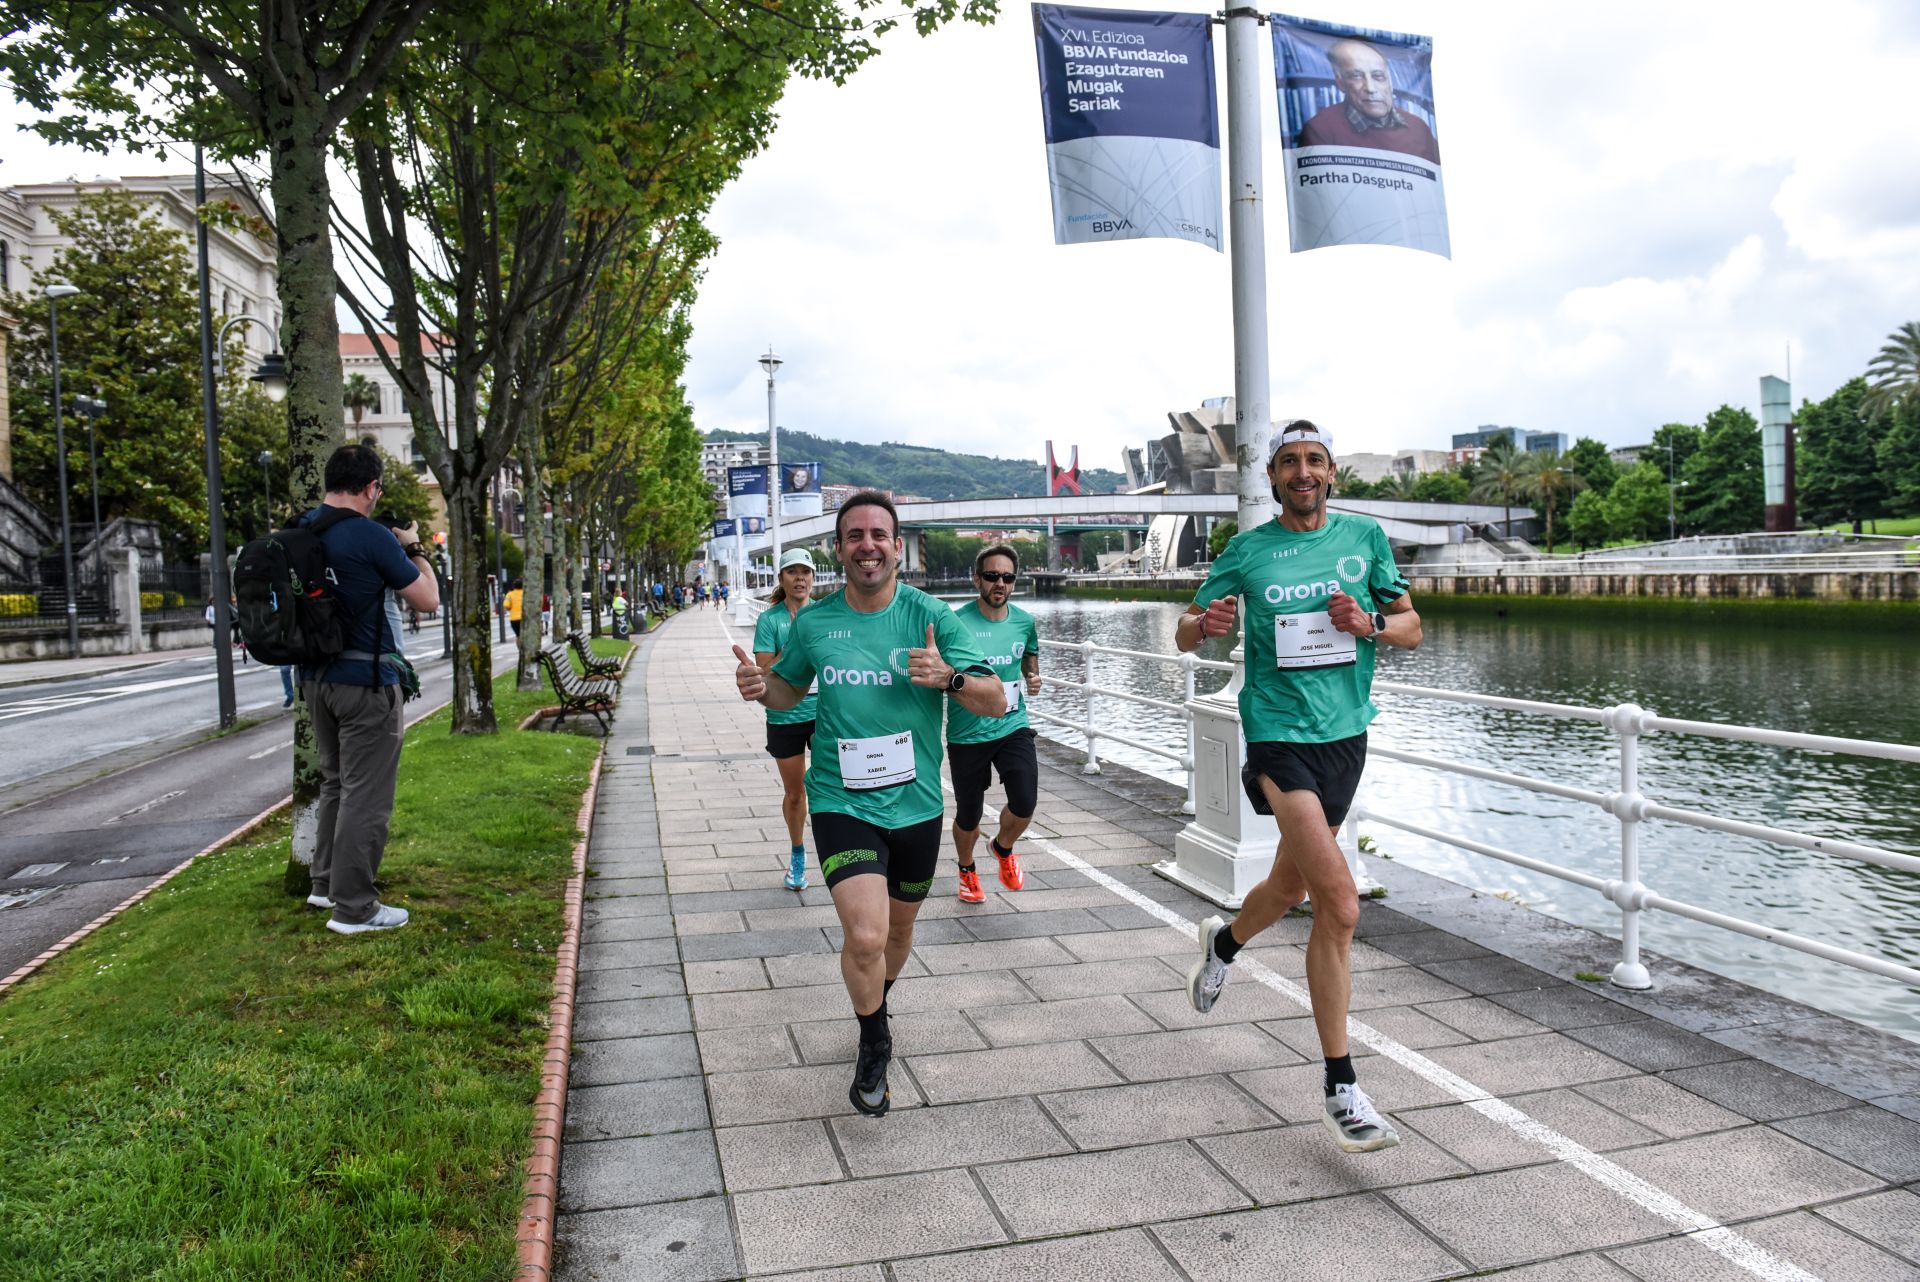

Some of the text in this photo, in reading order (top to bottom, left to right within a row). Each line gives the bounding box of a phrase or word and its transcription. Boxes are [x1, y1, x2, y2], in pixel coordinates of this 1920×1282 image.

[1060, 28, 1145, 45] XVI. Edizioa
[1063, 45, 1189, 65] BBVA Fundazioa
[1065, 62, 1165, 79] Ezagutzaren
[1067, 79, 1124, 95] Mugak
[1069, 97, 1121, 113] Sariak
[1300, 171, 1414, 191] Partha Dasgupta
[1092, 219, 1133, 233] BBVA
[1181, 223, 1202, 235] CSIC
[1264, 579, 1341, 604] Orona
[823, 665, 893, 686] Orona
[895, 736, 908, 746] 680
